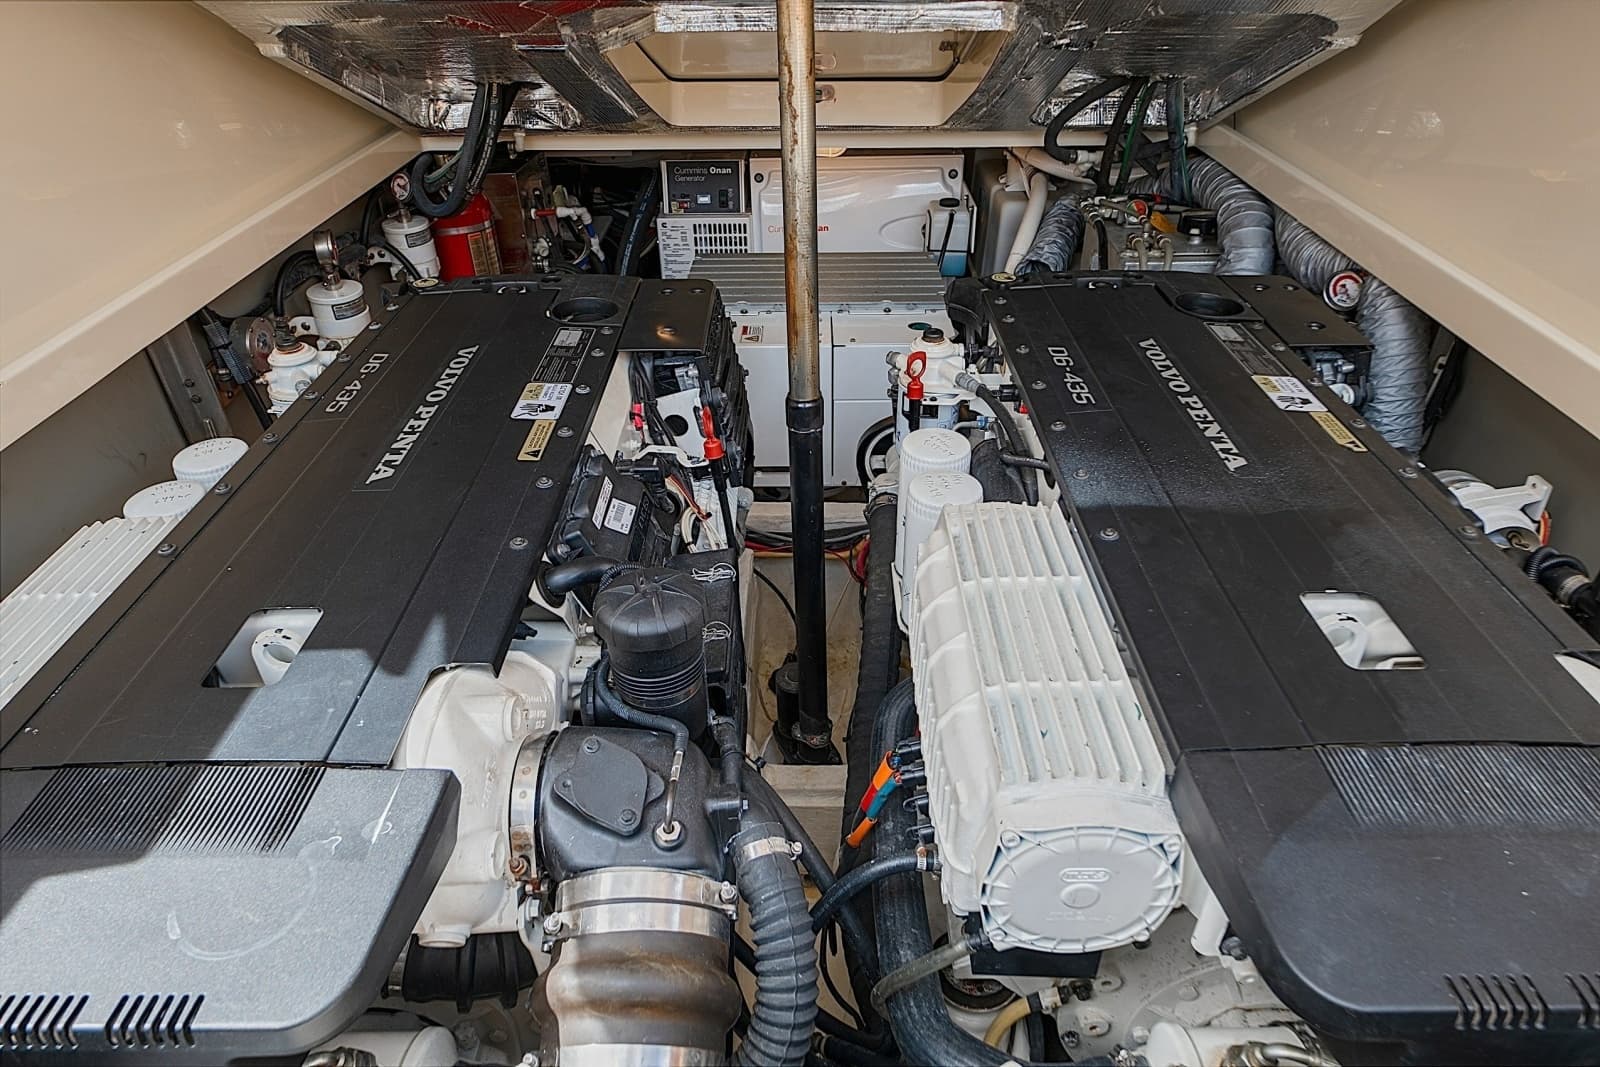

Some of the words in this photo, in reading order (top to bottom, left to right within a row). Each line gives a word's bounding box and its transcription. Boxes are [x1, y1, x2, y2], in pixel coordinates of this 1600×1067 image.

[674, 166, 708, 174] Cummins
[709, 166, 732, 174] Onan
[325, 353, 390, 413] D6-435
[425, 344, 480, 402] VOLVO
[1047, 346, 1097, 404] D6-435
[1138, 338, 1191, 393] VOLVO
[1177, 394, 1248, 471] PENTA
[365, 404, 439, 484] PENTA
